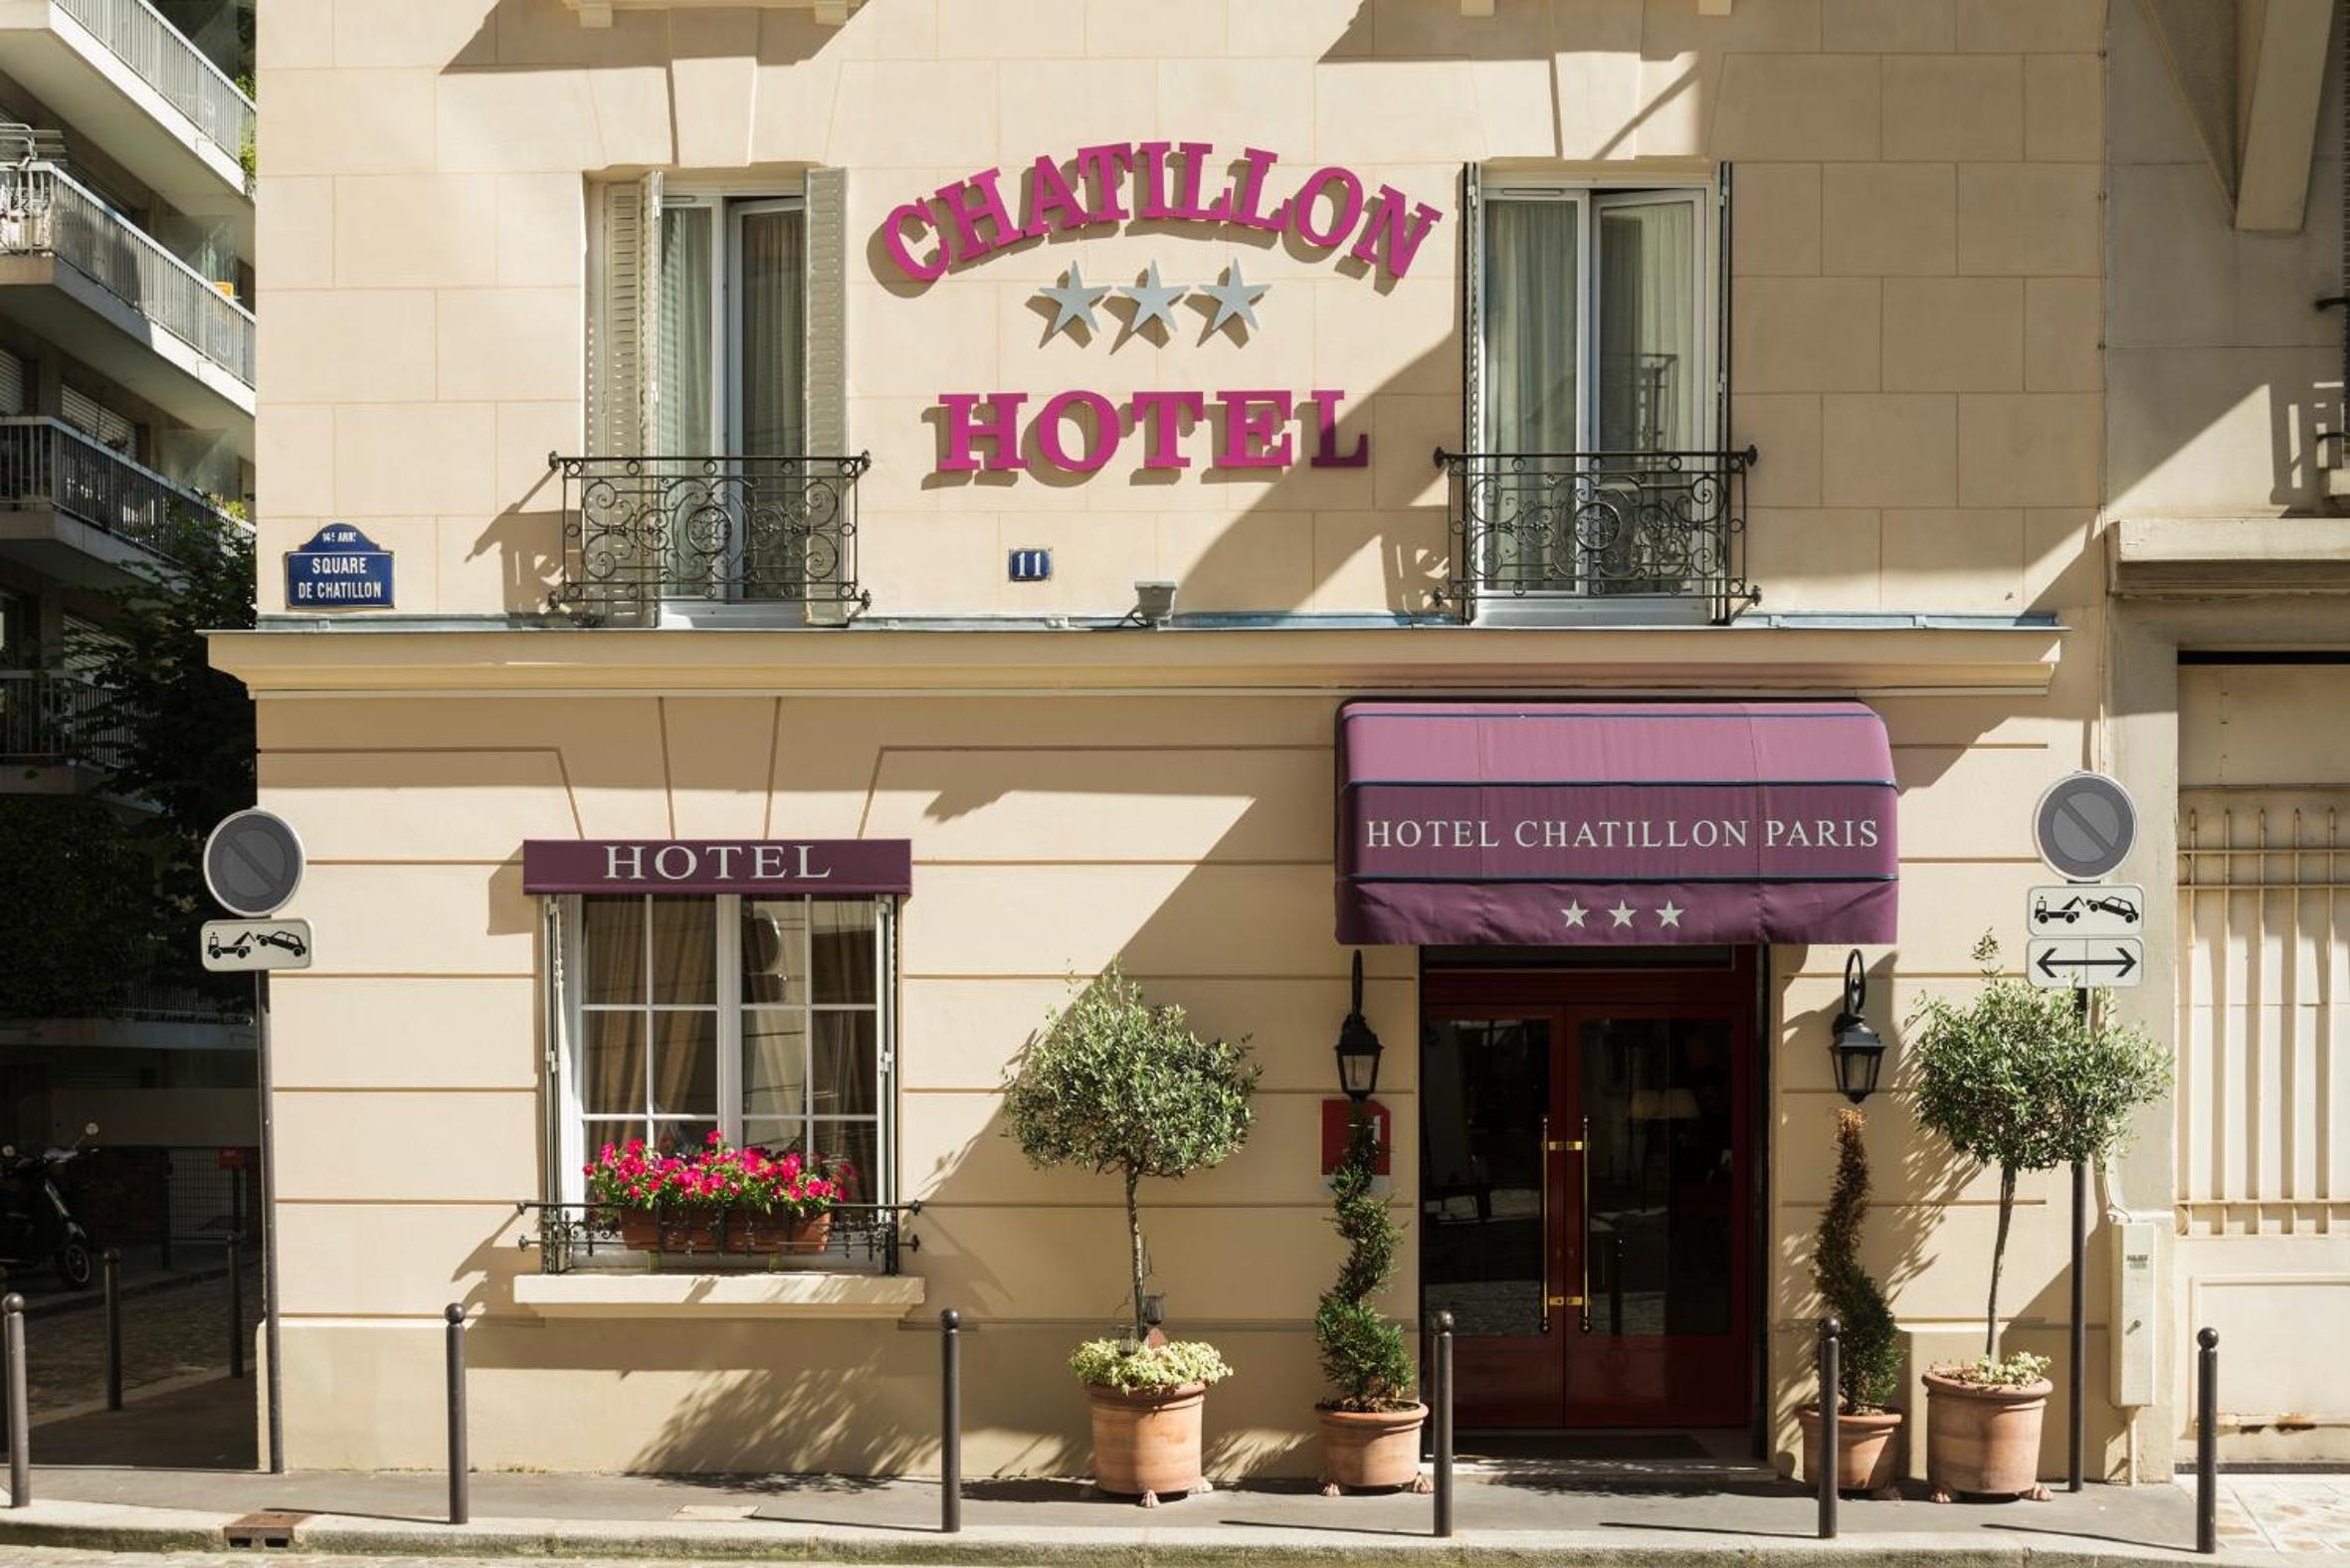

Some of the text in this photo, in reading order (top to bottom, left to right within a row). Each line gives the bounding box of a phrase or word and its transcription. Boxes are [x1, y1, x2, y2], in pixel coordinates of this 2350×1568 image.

[884, 141, 1444, 281] CHATILLON
[938, 390, 1369, 472] HOTEL
[312, 557, 366, 574] SQUARE
[1019, 552, 1042, 576] 11
[298, 581, 382, 599] DE CHATILLON
[1366, 820, 1878, 848] HOTEL CHATILLON PARIS
[603, 845, 832, 880] HOTEL
